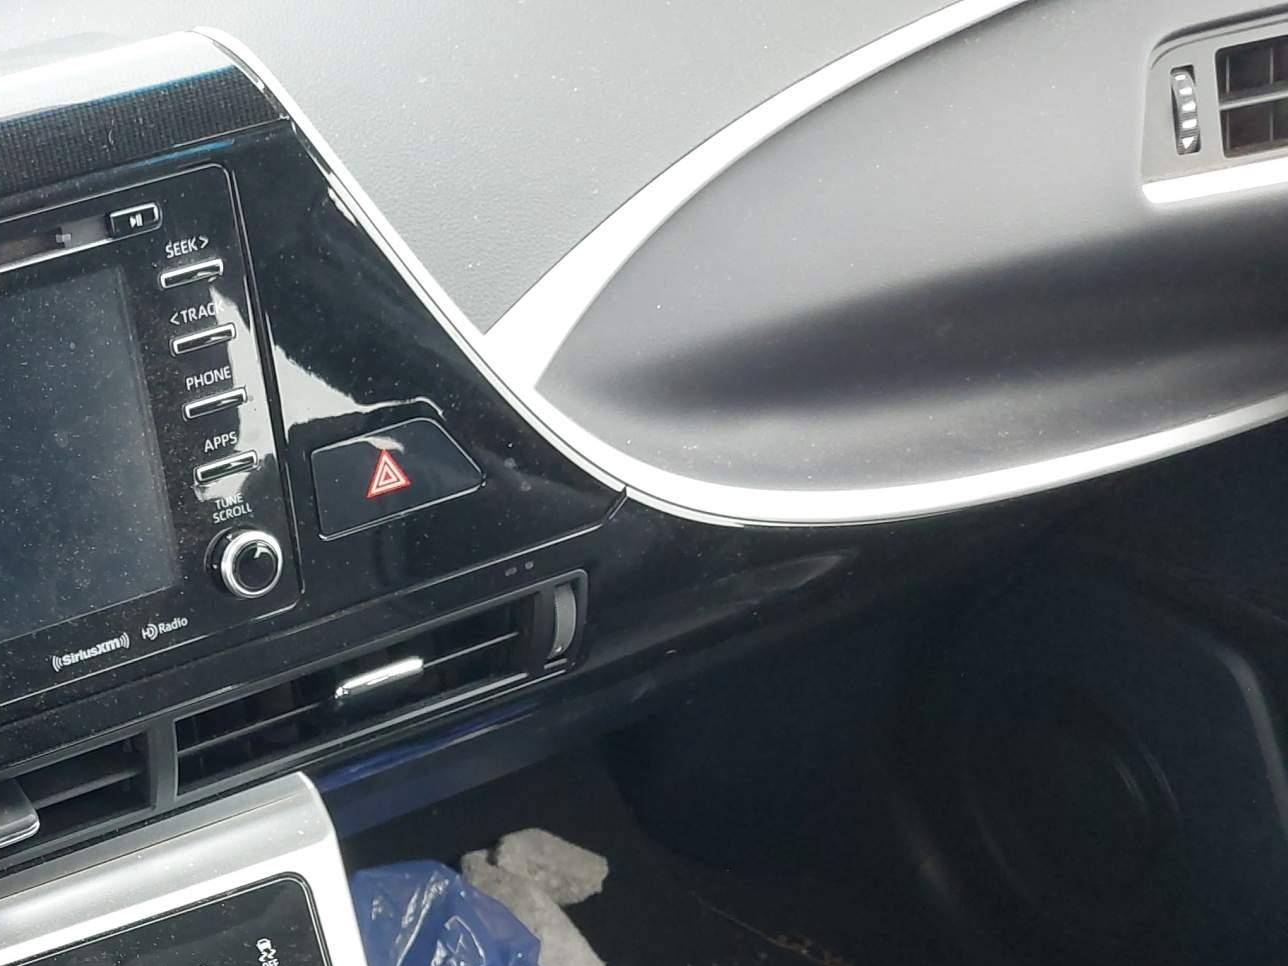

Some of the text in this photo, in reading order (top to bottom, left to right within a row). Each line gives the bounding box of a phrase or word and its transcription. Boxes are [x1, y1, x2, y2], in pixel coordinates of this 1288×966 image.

[165, 237, 199, 259] SEEK
[186, 365, 232, 391] PHONE
[204, 431, 238, 452] APPS
[214, 493, 244, 510] TUNE
[212, 503, 252, 524] SCROLL
[158, 617, 189, 634] Radio
